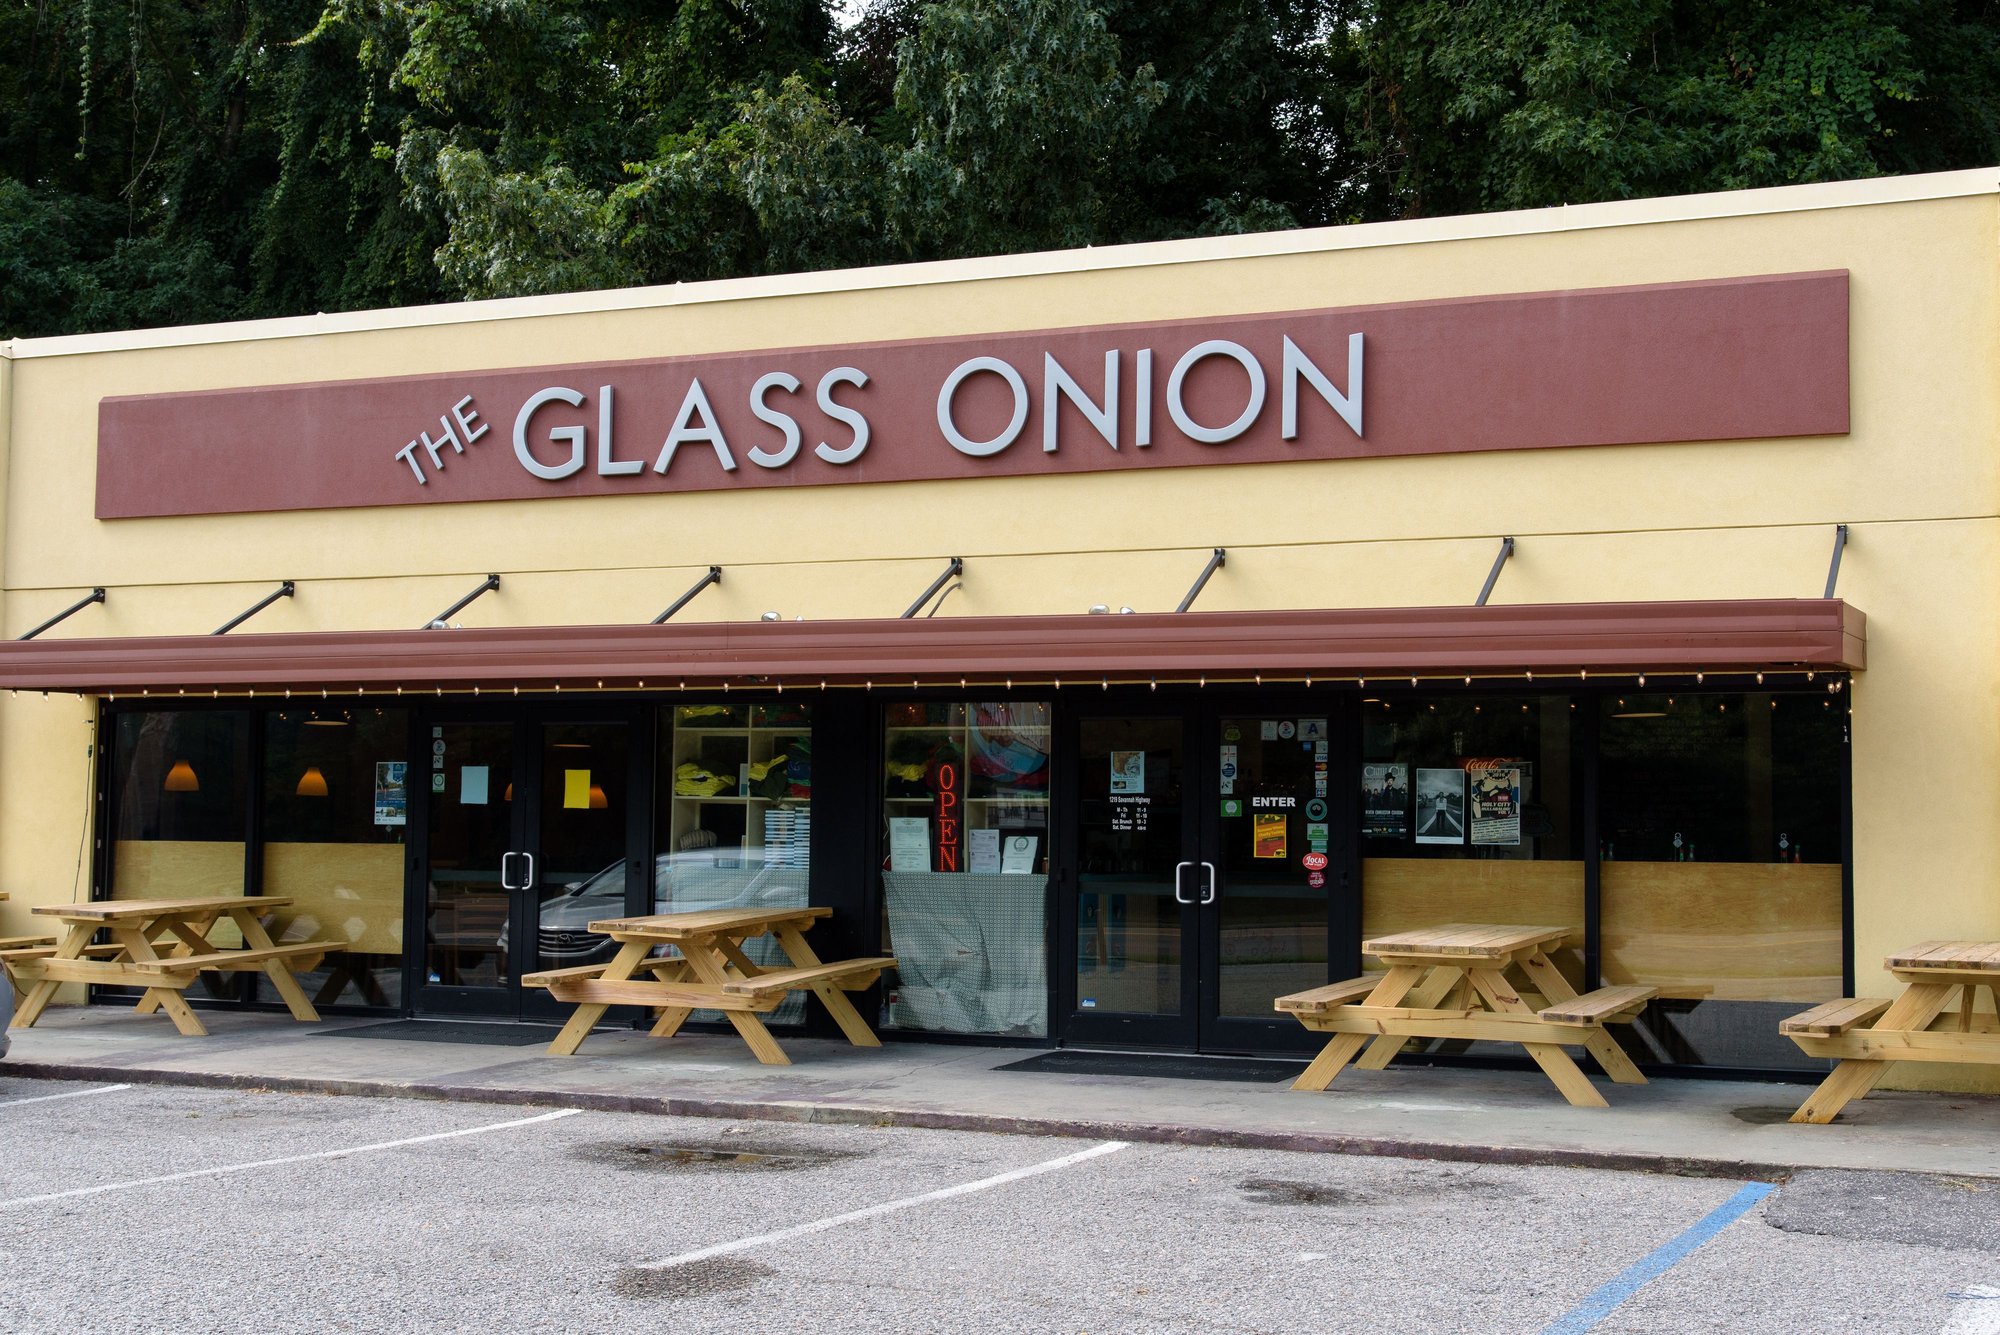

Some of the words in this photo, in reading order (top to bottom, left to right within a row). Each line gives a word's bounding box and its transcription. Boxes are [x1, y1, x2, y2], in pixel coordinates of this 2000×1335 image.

[395, 394, 491, 485] THE
[512, 366, 872, 481] GLASS
[936, 331, 1364, 457] ONION
[1308, 723, 1319, 734] A
[1135, 796, 1150, 805] Highway
[1252, 797, 1296, 807] ENTER
[938, 764, 958, 872] OPEN
[1306, 855, 1324, 865] LOCAL
